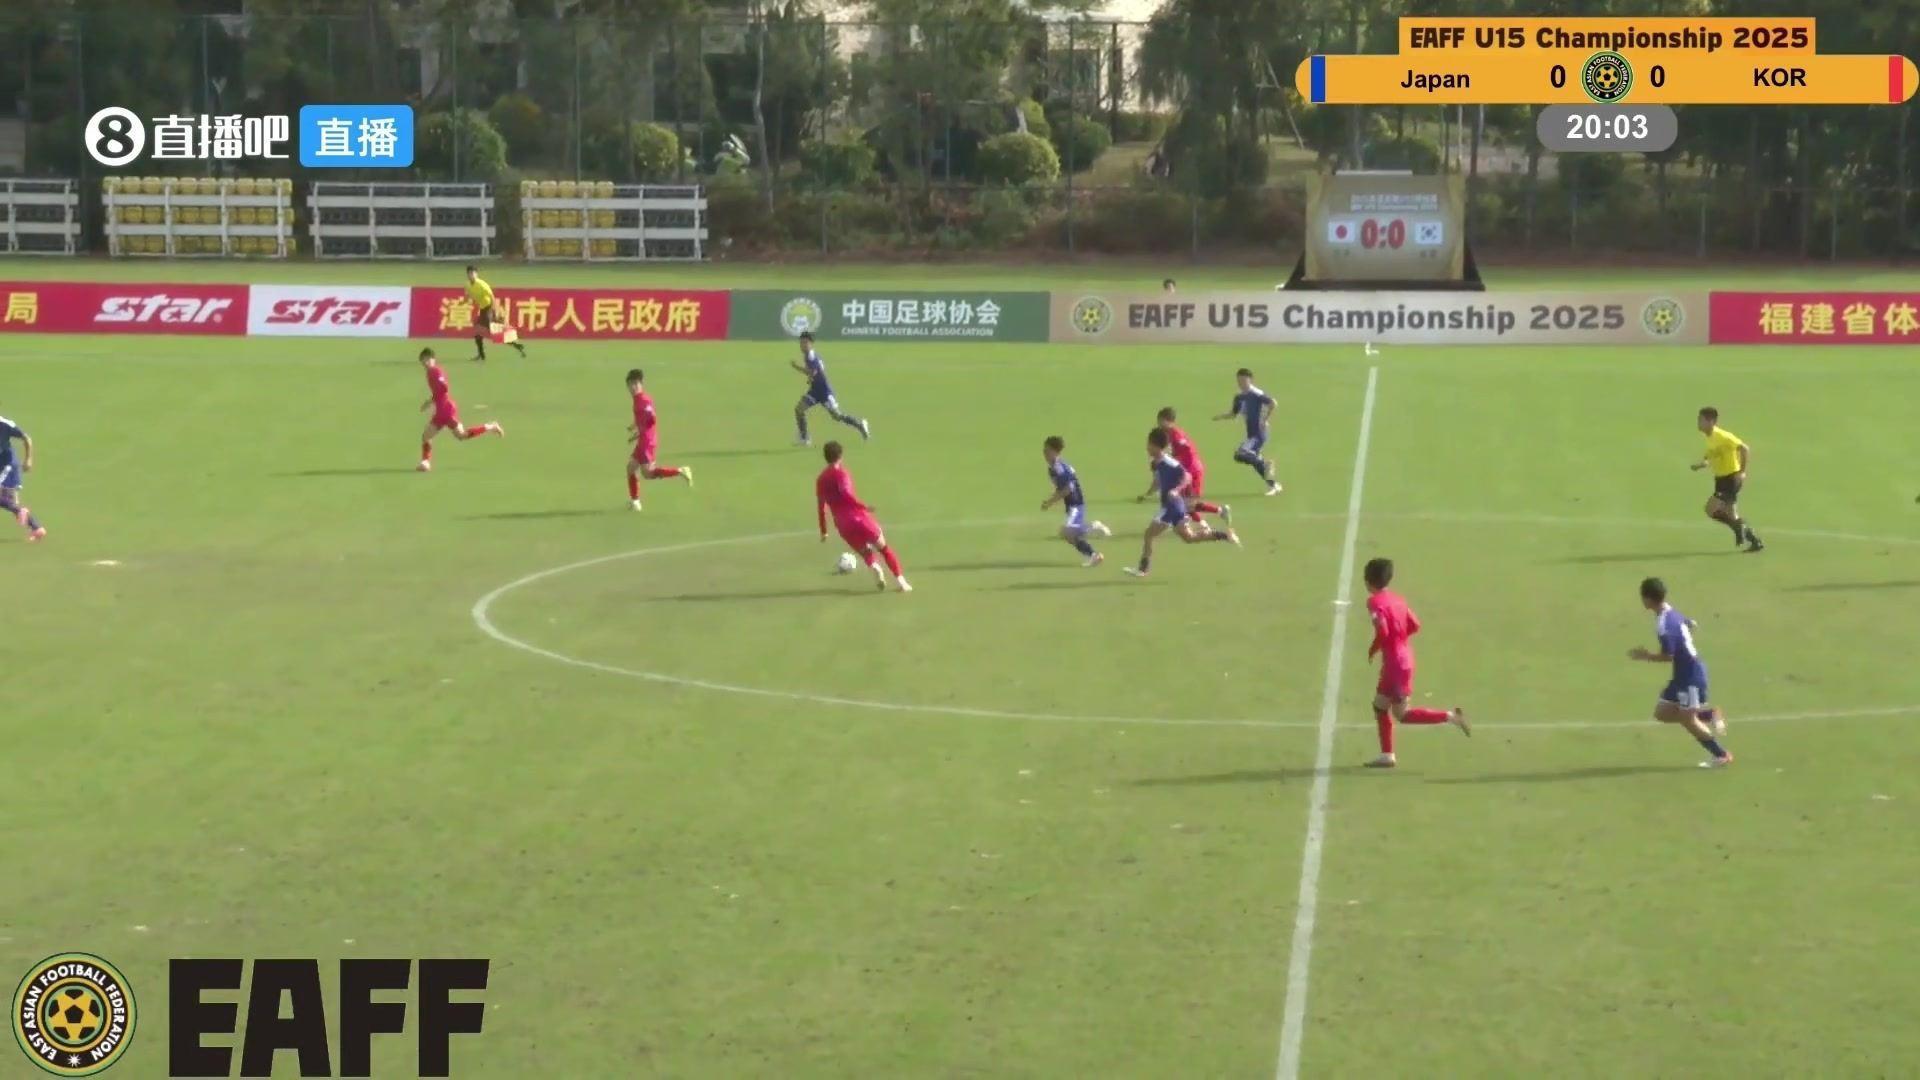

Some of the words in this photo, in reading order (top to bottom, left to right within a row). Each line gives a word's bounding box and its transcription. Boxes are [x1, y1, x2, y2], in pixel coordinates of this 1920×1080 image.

[1360, 217, 1406, 250] 0:0
[4, 292, 38, 324] 局
[842, 299, 1001, 325] 中国足球协会
[1128, 303, 1196, 328] EAFF
[1208, 303, 1270, 328] U15
[1283, 303, 1516, 335] Championship
[1529, 304, 1625, 330] 2025
[1759, 301, 1920, 336] 福建省体
[883, 326, 929, 337] FOOTBALL
[932, 326, 993, 337] ASSOCIATION
